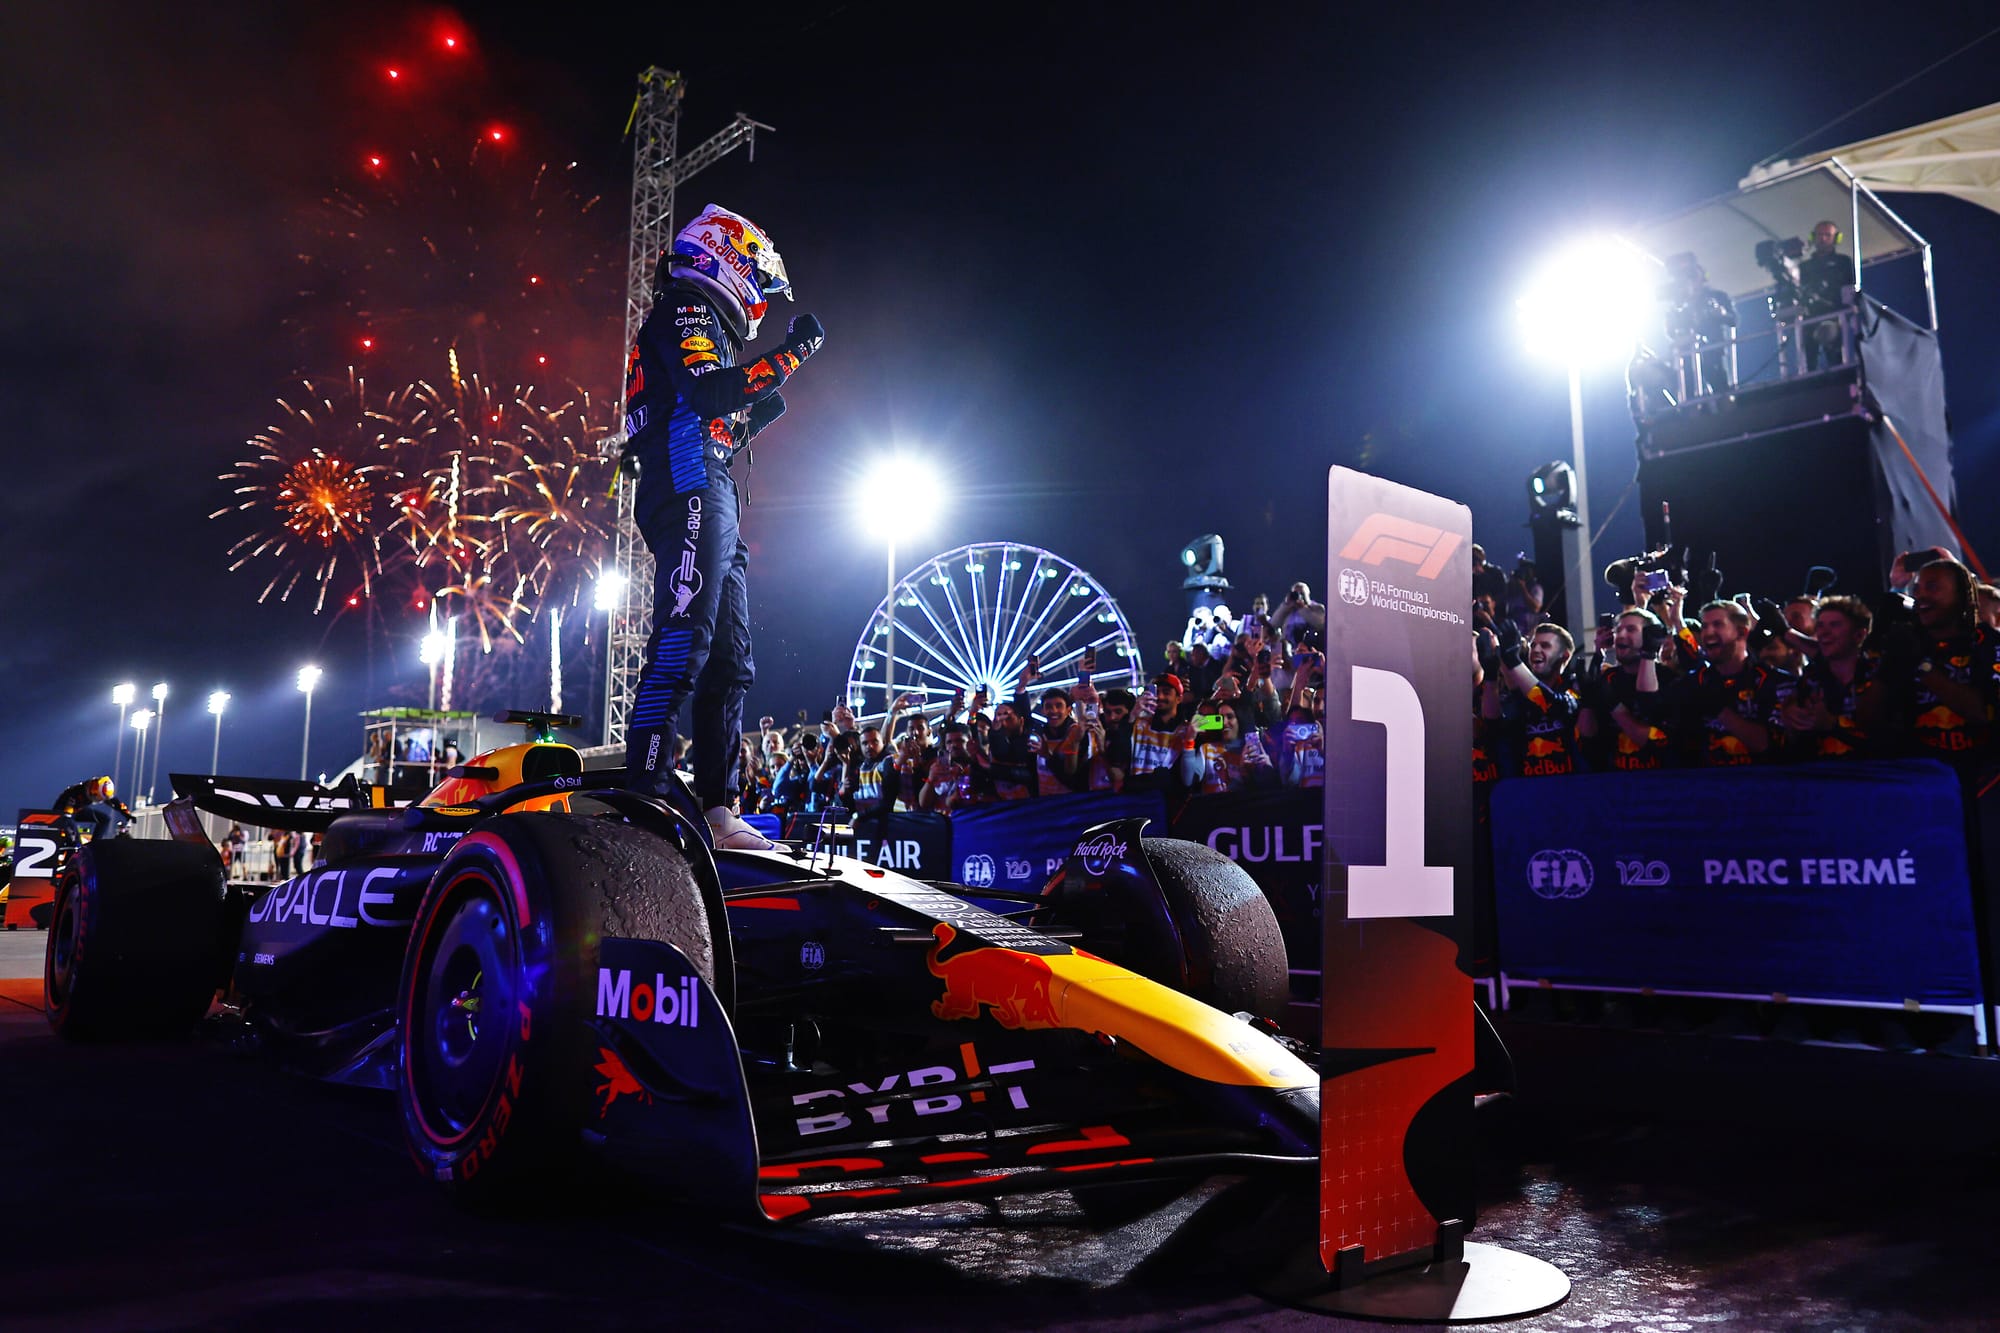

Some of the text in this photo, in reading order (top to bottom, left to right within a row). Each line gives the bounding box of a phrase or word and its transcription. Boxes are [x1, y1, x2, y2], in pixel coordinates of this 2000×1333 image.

[674, 316, 708, 327] Claro
[676, 304, 707, 314] Mobil
[1338, 512, 1464, 581] F1
[1371, 581, 1387, 595] FIA
[1371, 594, 1399, 611] World
[647, 733, 662, 772] sparco
[566, 775, 582, 787] Sui
[1347, 665, 1455, 919] 1
[14, 837, 57, 878] 2
[877, 839, 921, 869] AIR
[1073, 841, 1104, 856] Hard
[1207, 824, 1324, 863] GULF
[1615, 859, 1671, 886] 120
[1703, 858, 1789, 885] PARC
[1801, 849, 1917, 885] FERMÉ
[249, 867, 408, 929] ORACLE
[253, 953, 275, 966] SIEMENS
[596, 968, 698, 1028] Mobil
